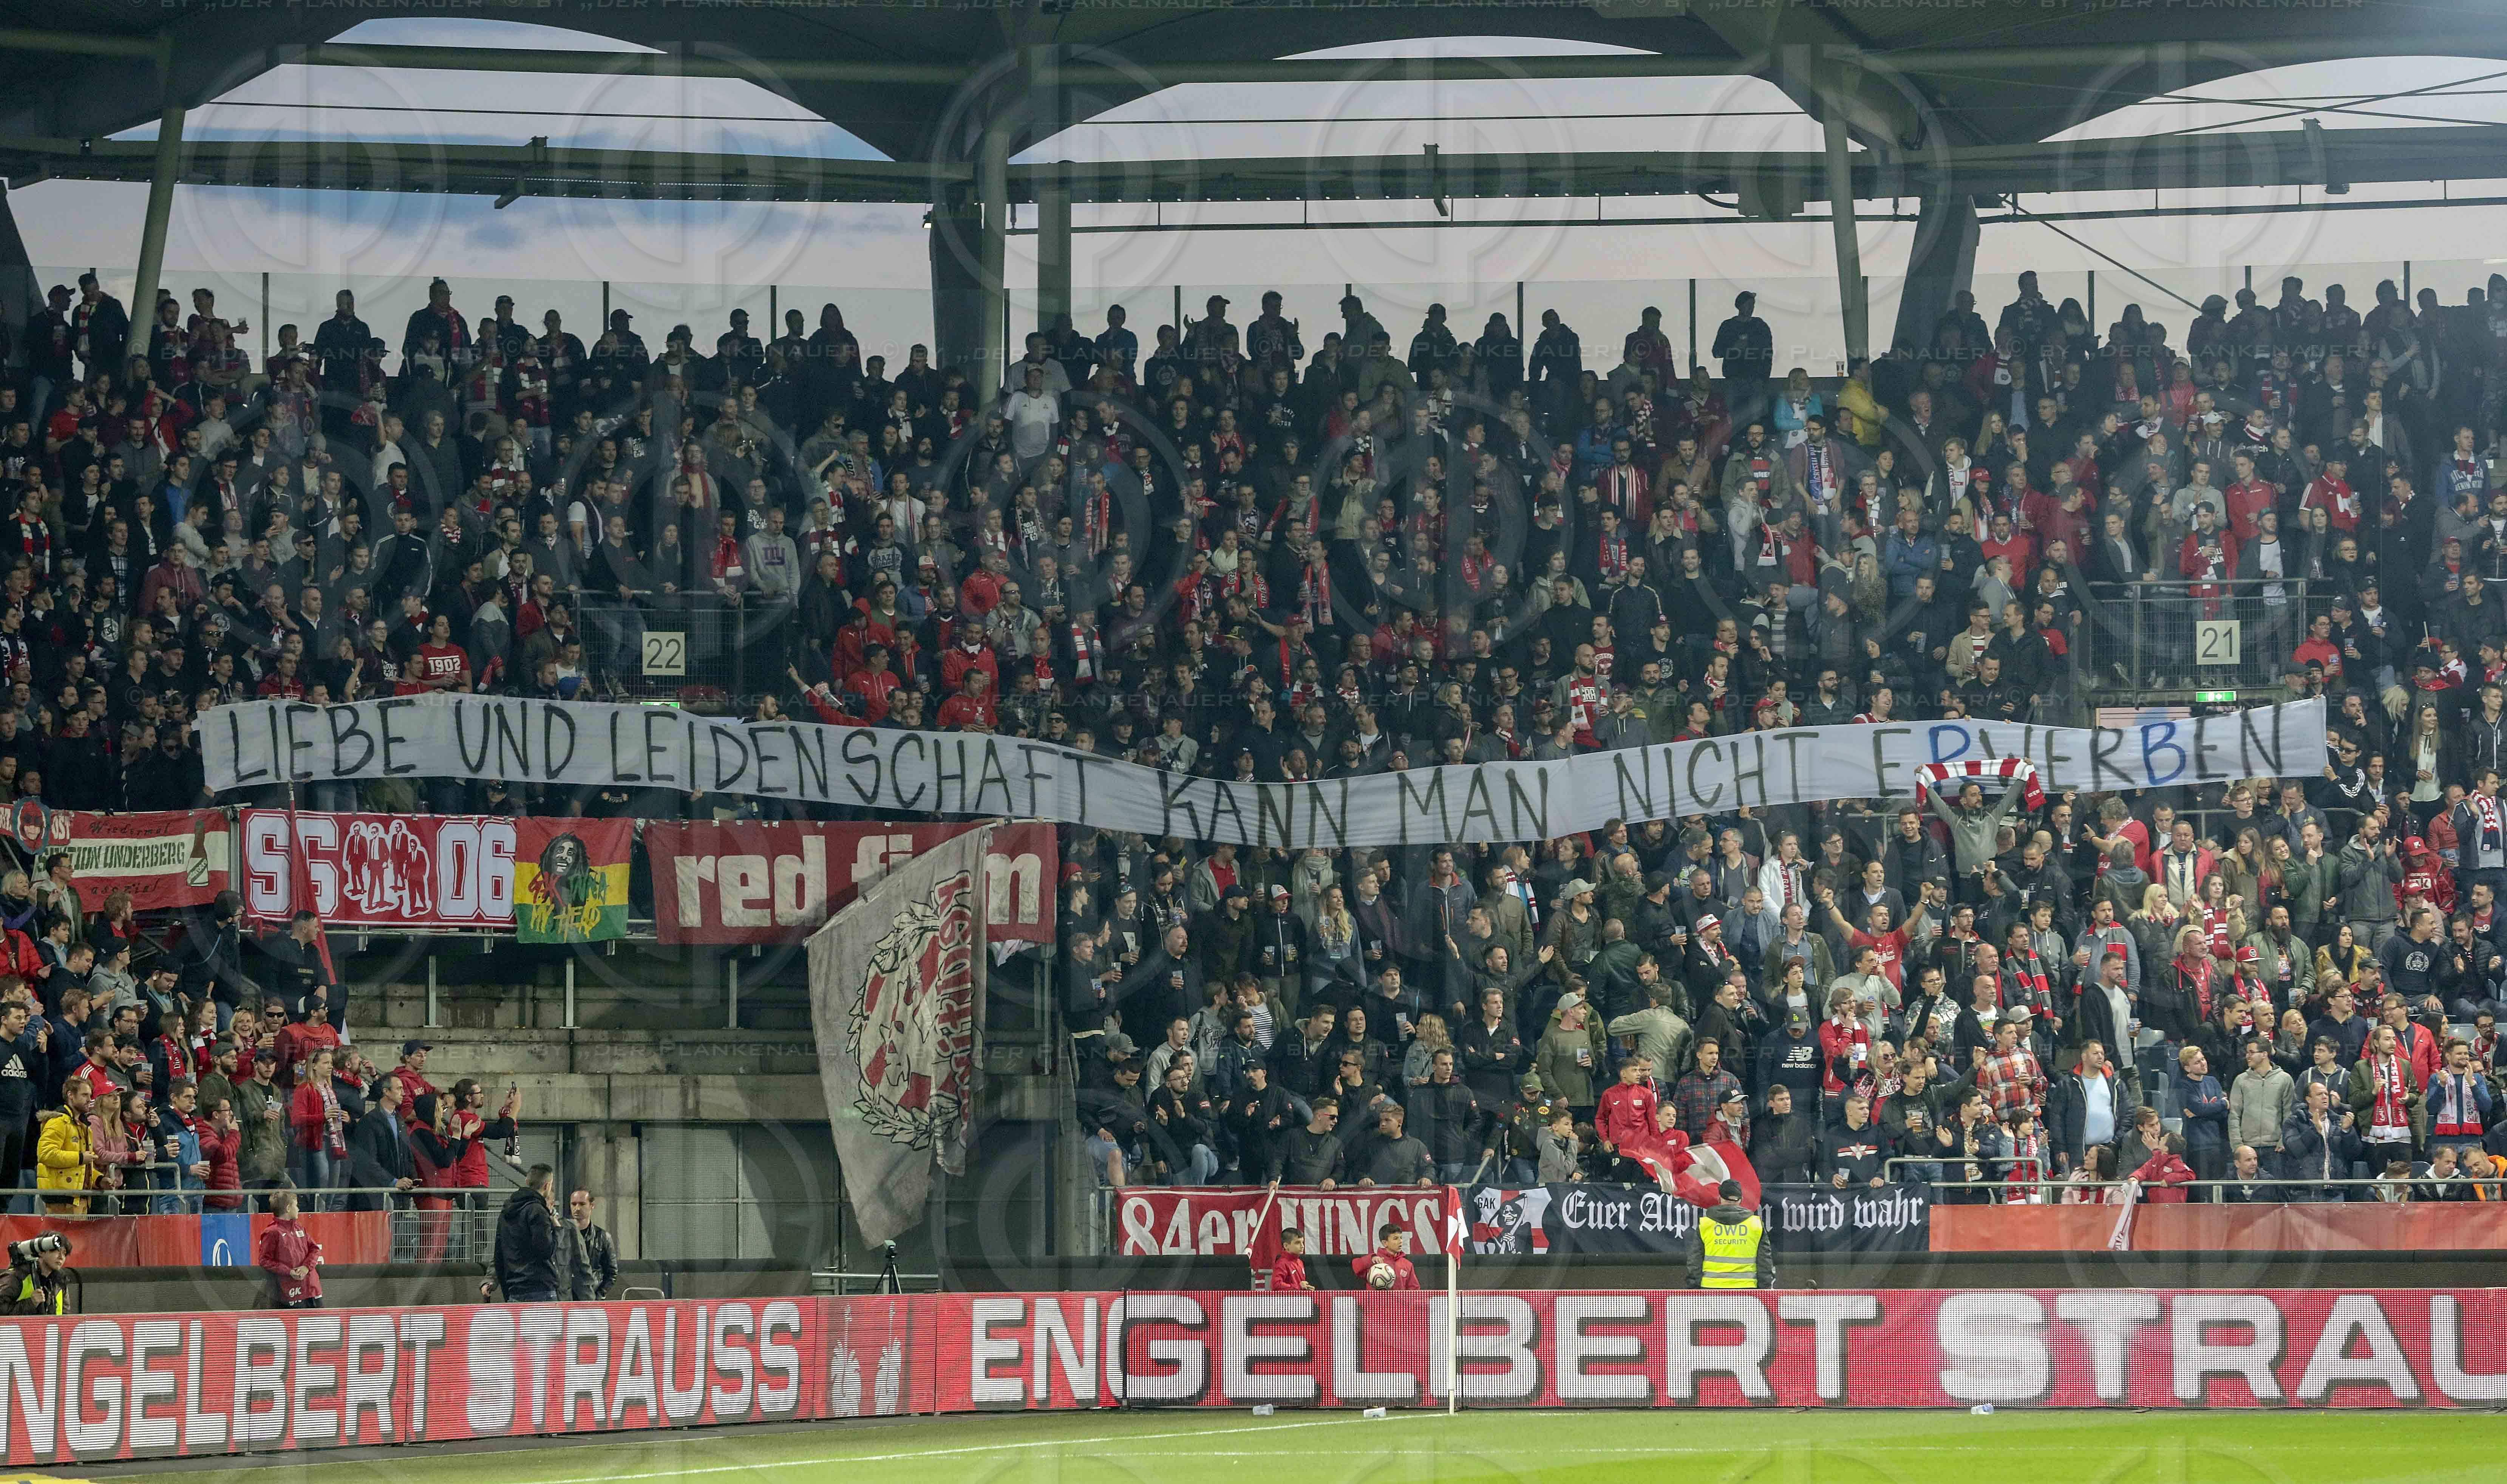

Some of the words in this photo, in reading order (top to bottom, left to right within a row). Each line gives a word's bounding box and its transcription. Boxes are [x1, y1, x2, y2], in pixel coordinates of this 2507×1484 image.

[646, 638, 681, 669] 22
[2202, 626, 2234, 659] 21
[429, 658, 461, 674] 1902
[229, 698, 417, 782] LIEBE
[455, 699, 575, 780] UND
[609, 710, 1113, 824] LEIDENSCHAFT
[1157, 769, 1348, 848] KANN
[1397, 767, 1547, 845] MAN
[1613, 732, 1819, 822] NICHT
[104, 841, 185, 869] UNDERBERG
[437, 820, 517, 921] 06
[674, 835, 827, 928] red
[851, 833, 1042, 925] fim
[1, 1068, 27, 1078] adidas
[1478, 1196, 1495, 1210] GAK
[1561, 1192, 1631, 1230] Euer
[1782, 1192, 1846, 1231] wird
[1853, 1187, 1921, 1234] wahr
[1121, 1197, 1257, 1255] 84er
[289, 1287, 301, 1297] GK
[466, 1301, 802, 1433] STRAUSS
[971, 1294, 1879, 1402] ENGELBERT
